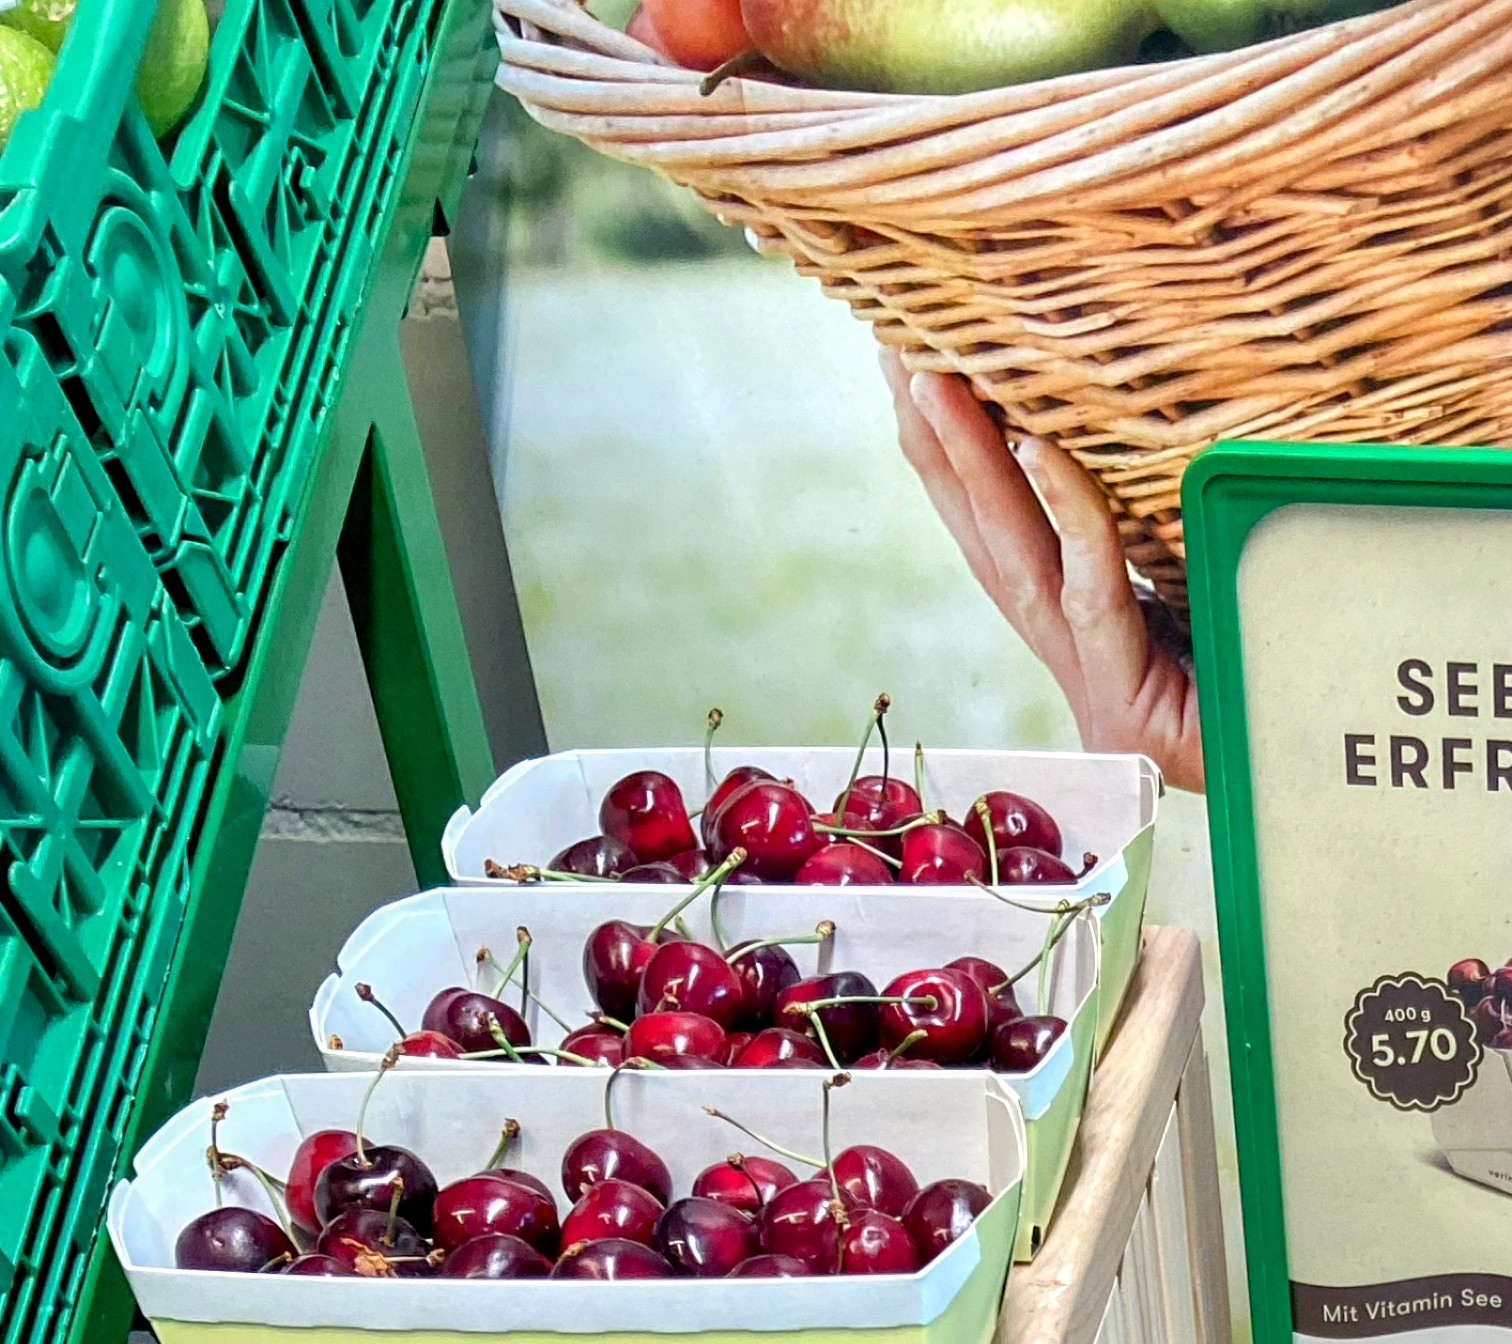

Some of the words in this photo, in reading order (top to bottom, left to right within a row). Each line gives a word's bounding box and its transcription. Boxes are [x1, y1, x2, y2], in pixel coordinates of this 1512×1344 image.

[1384, 1007, 1417, 1022] 400
[1420, 1010, 1431, 1022] g
[1371, 1028, 1457, 1067] 5.70
[1322, 1304, 1359, 1323] Mit
[1365, 1292, 1453, 1320] Vitamin
[1460, 1288, 1503, 1309] See
